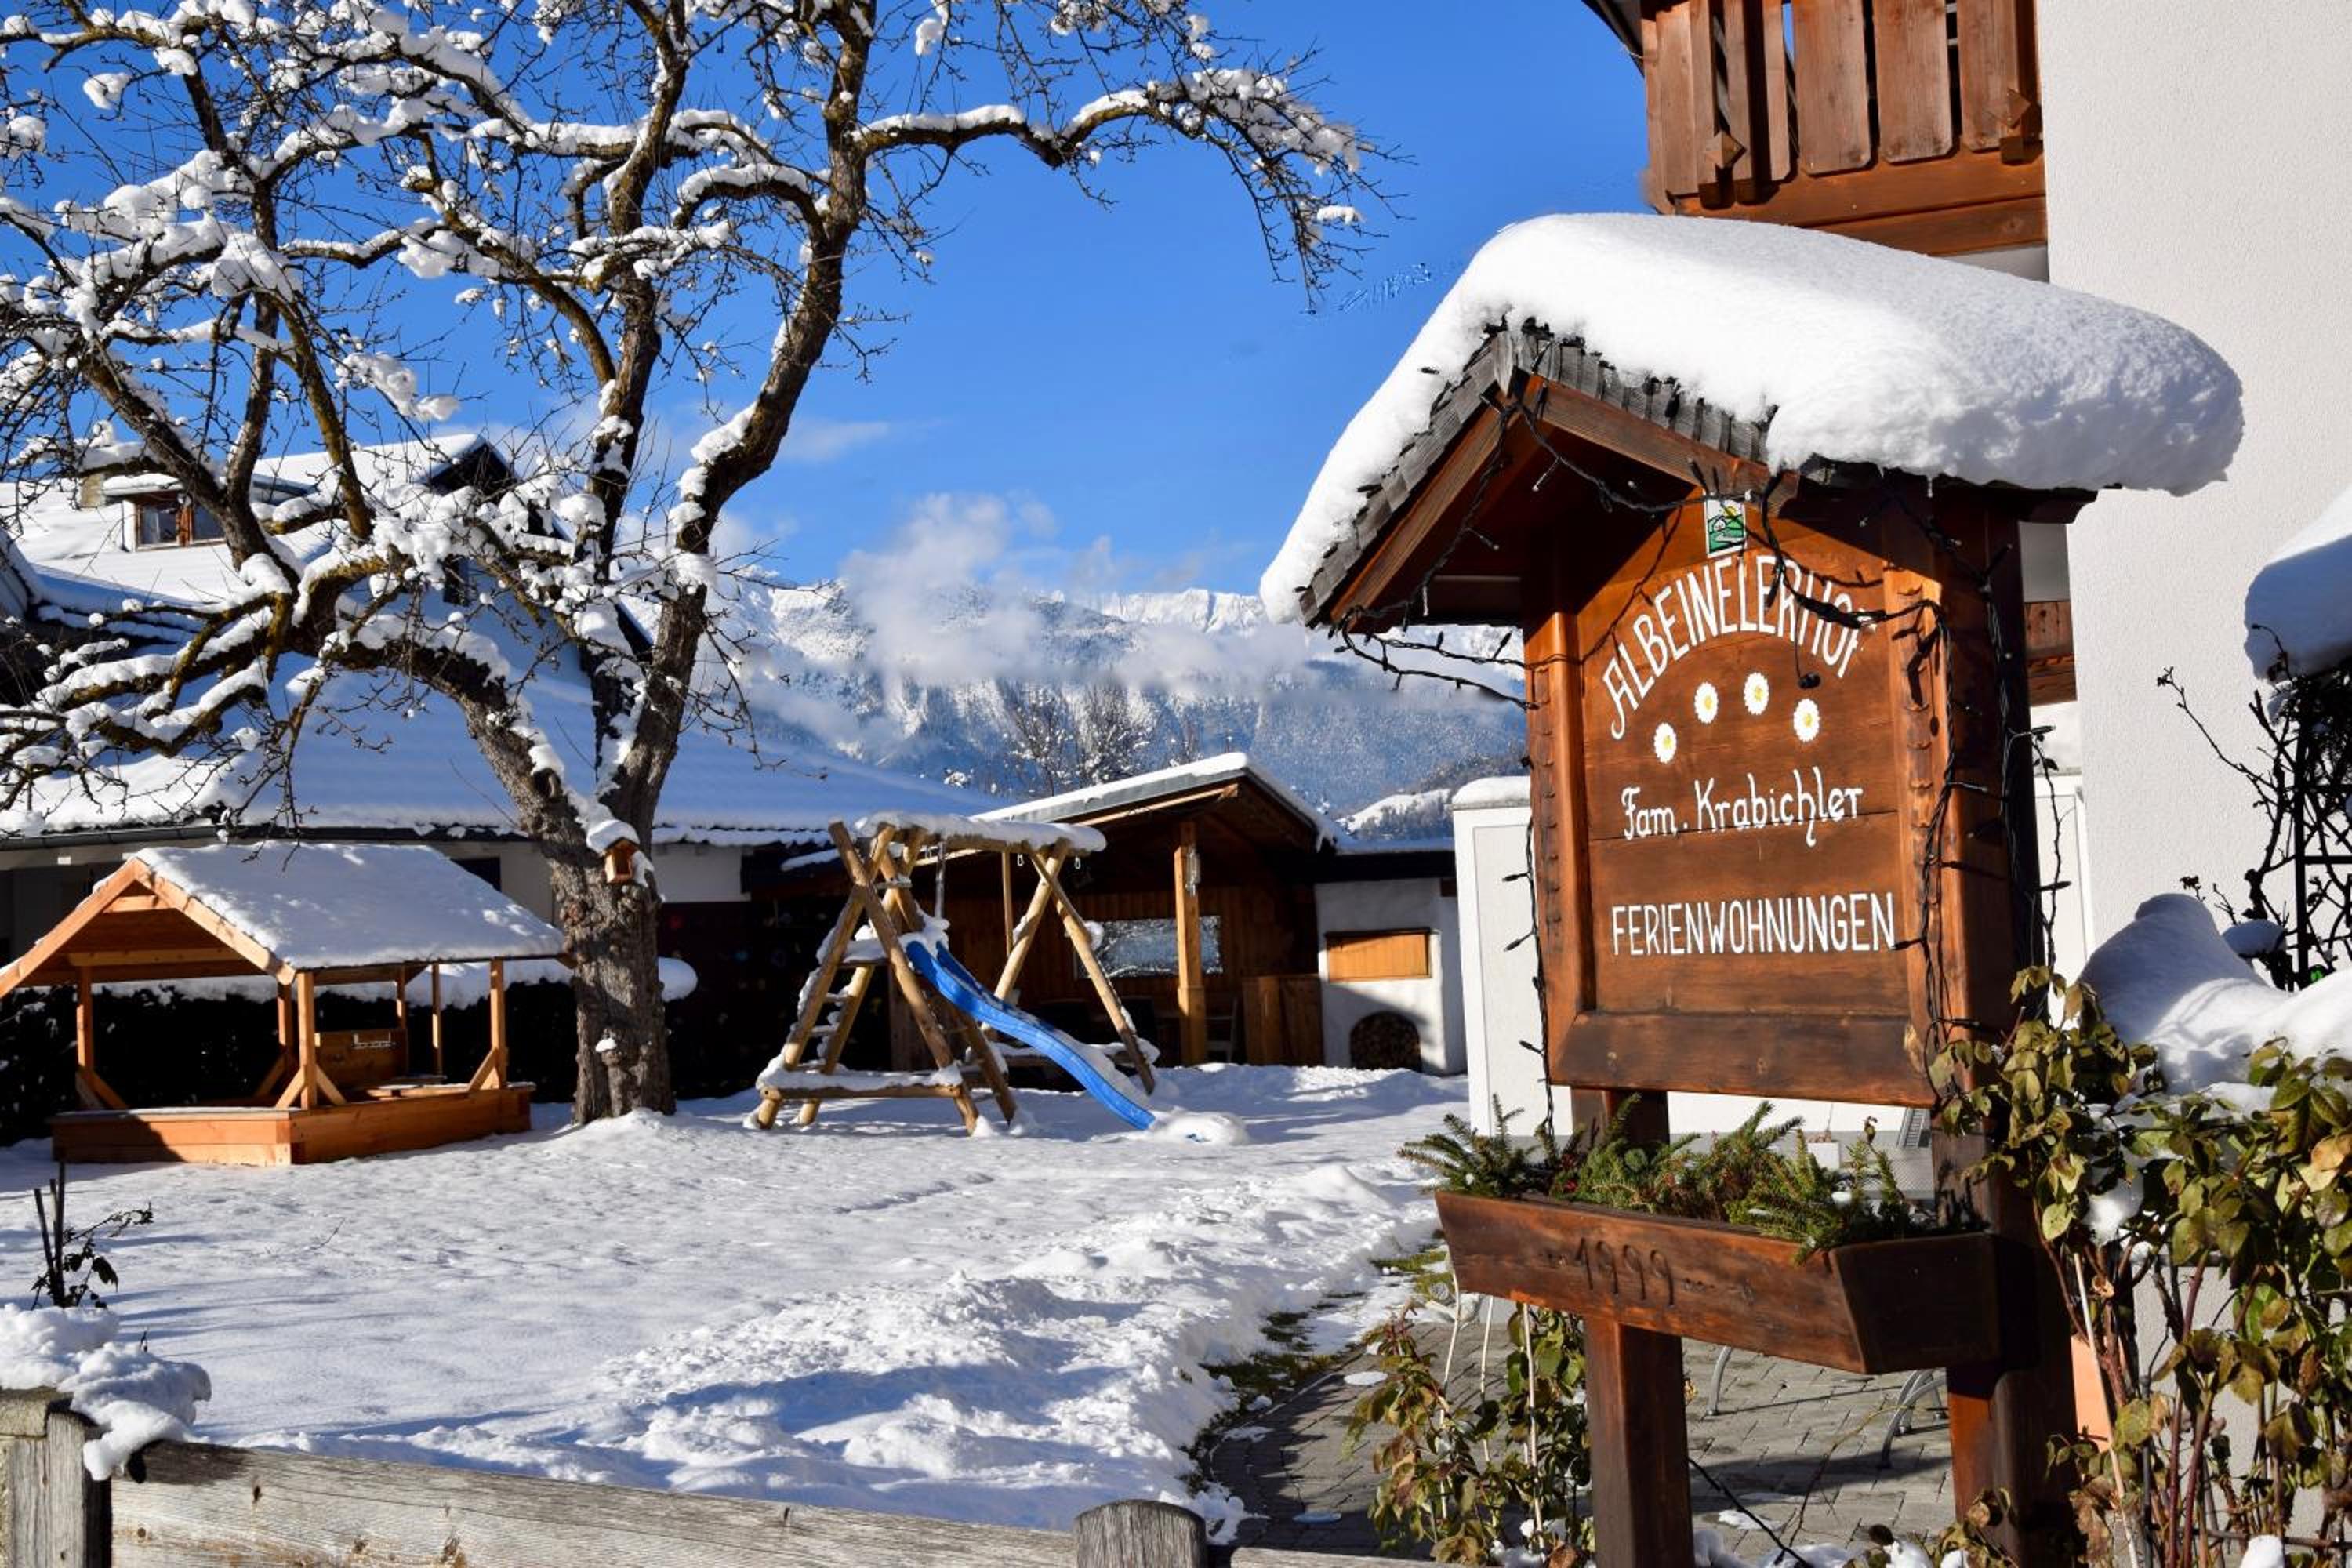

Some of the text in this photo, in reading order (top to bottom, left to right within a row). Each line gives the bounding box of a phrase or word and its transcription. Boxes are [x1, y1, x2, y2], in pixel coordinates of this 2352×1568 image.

[1621, 766, 1864, 847] Fam. Krabichler
[1611, 891, 1896, 956] FERIENWOHNUNGEN
[1575, 1237, 1675, 1306] 1999
